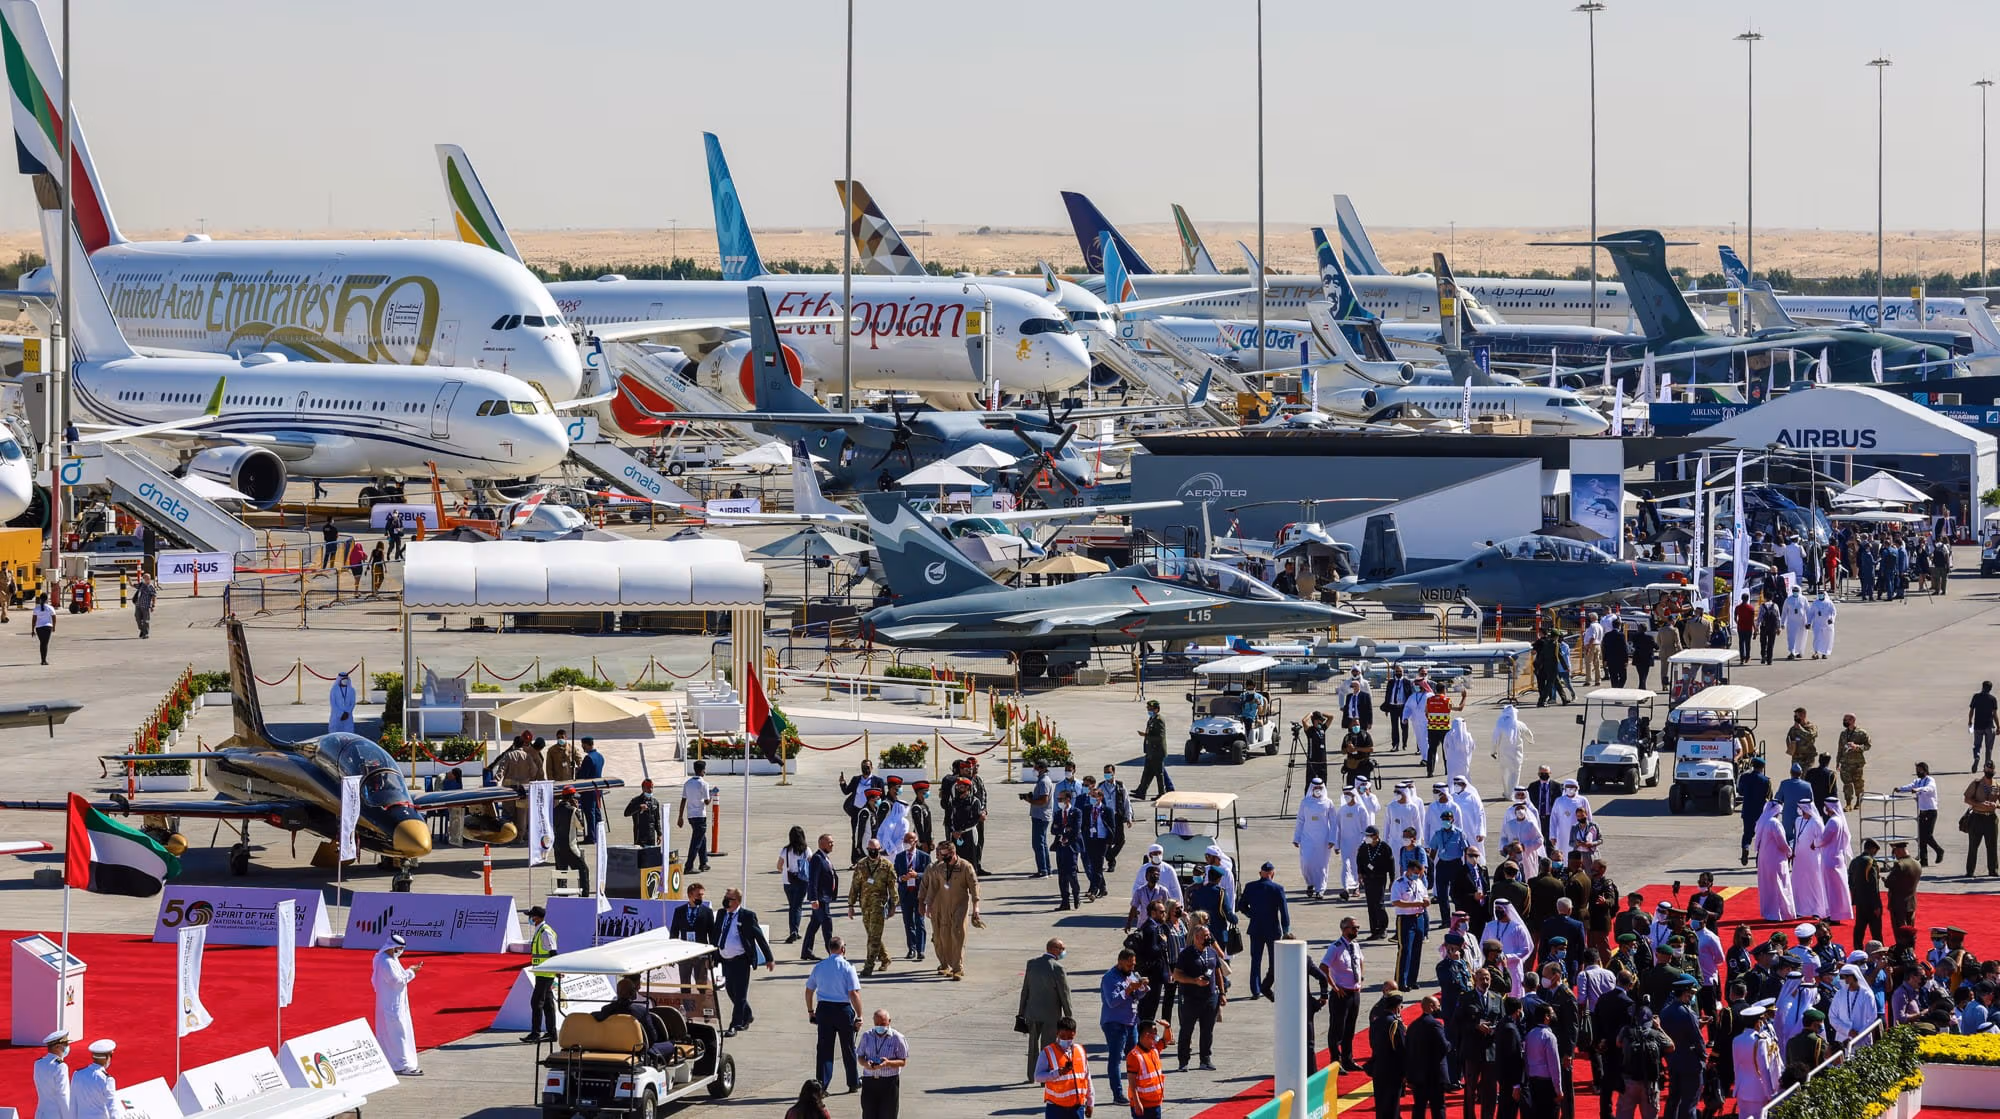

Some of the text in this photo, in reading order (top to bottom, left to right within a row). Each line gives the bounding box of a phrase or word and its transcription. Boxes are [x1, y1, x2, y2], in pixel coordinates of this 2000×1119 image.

[725, 256, 748, 273] 777
[1265, 287, 1325, 299] ETIHA
[1491, 288, 1555, 299] السعودية
[109, 269, 440, 365] United Arab Emirates 50
[775, 291, 964, 350] Ethopian
[1690, 408, 1721, 416] AIRLINK
[1775, 429, 1877, 449] AIRBUS
[623, 466, 661, 495] dnata
[1185, 489, 1247, 497] AEROTER
[138, 482, 189, 523] dnata
[385, 512, 426, 522] ARBUS
[173, 562, 219, 574] AIRBUS
[1419, 588, 1469, 601] N610AT
[1188, 609, 1212, 622] L15
[215, 911, 276, 920] SPIRIT OF THE
[405, 930, 443, 939] EMIRATES
[331, 1056, 346, 1069] SPIRIT
